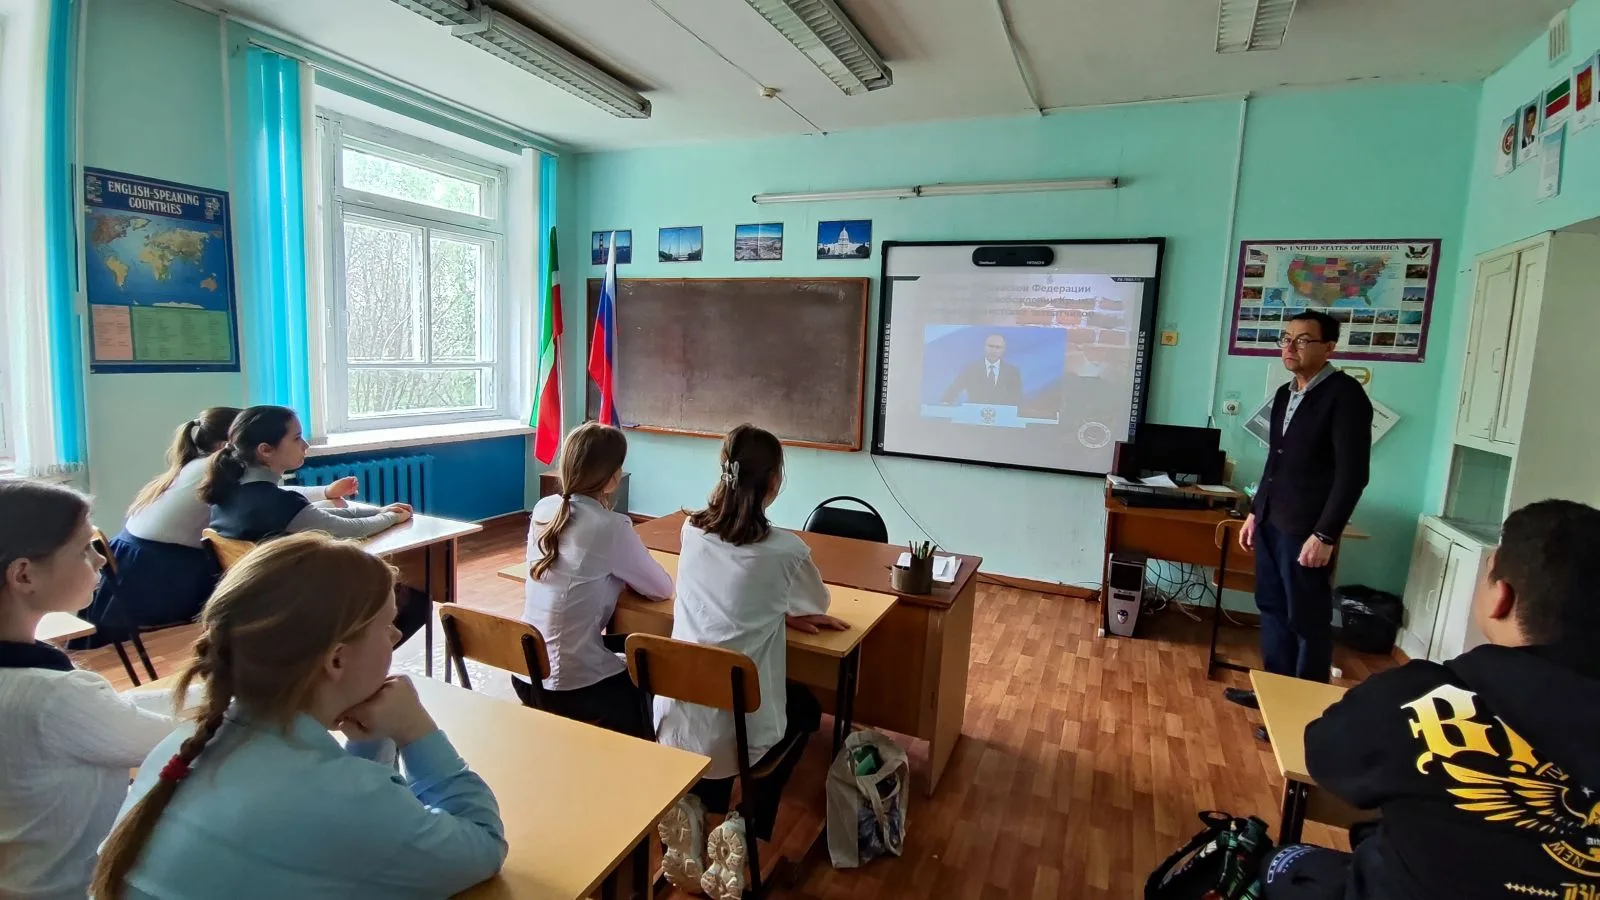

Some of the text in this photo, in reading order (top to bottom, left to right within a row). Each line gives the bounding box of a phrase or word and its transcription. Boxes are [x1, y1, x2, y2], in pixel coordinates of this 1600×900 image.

[107, 180, 200, 207] ENGLISH-SPEAKING
[128, 196, 183, 215] COUNTRIES
[1032, 284, 1091, 294] Федерации
[1549, 841, 1585, 868] NEW
